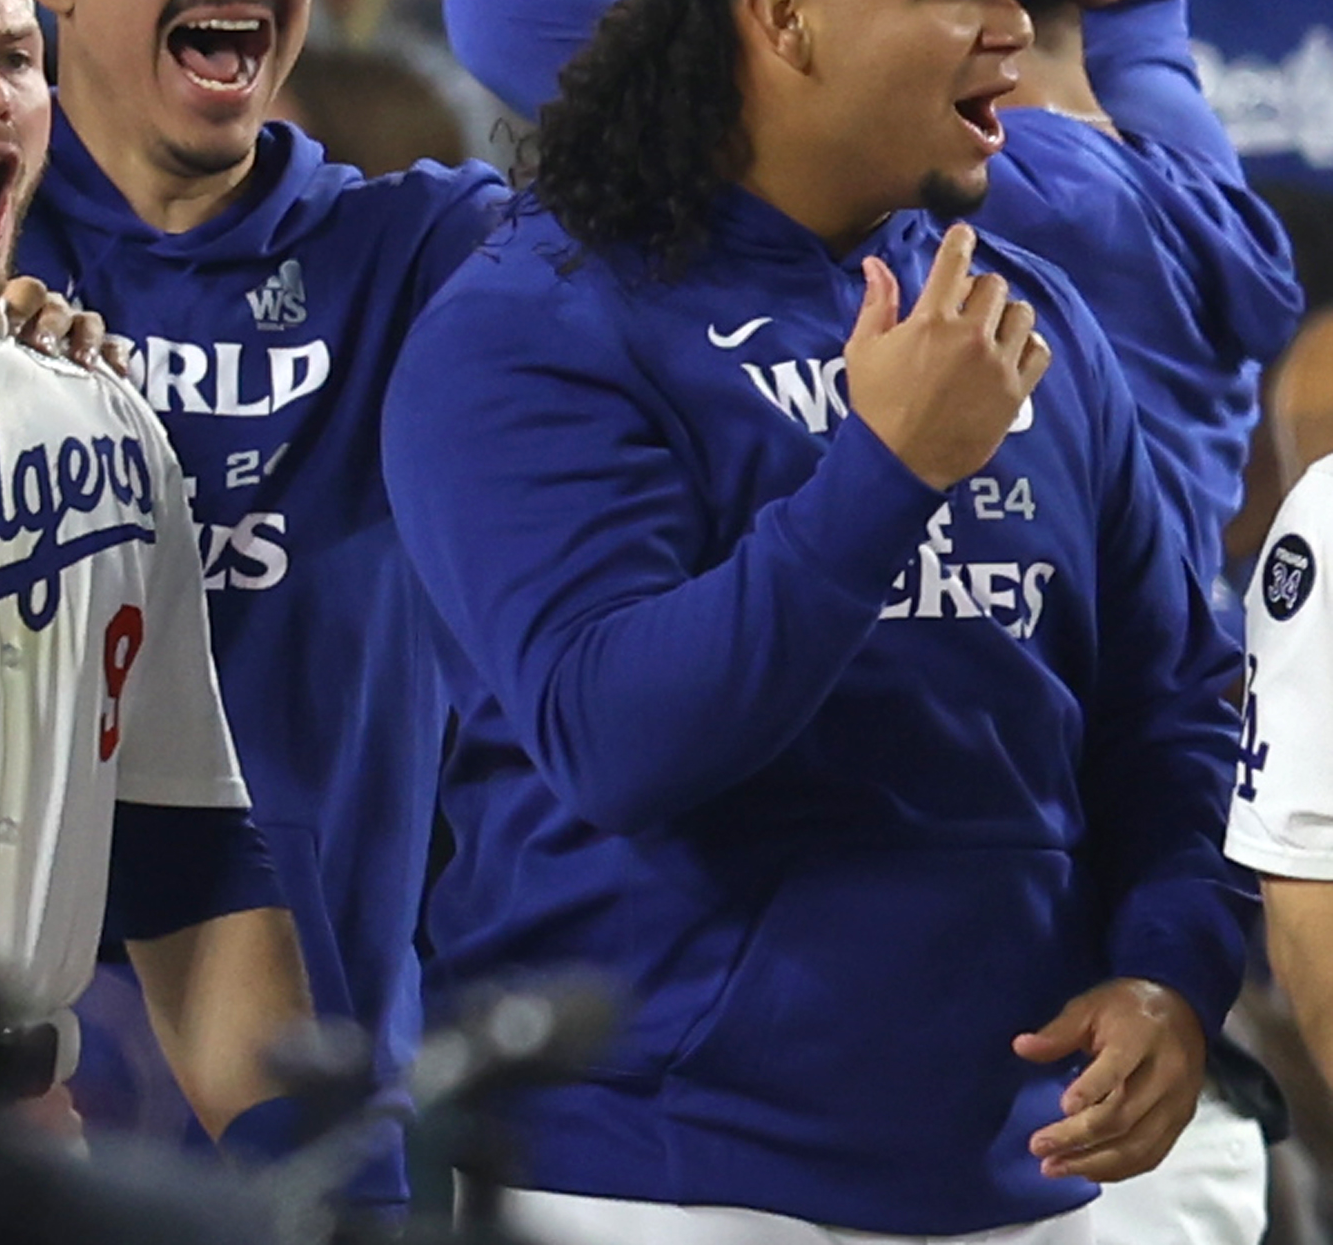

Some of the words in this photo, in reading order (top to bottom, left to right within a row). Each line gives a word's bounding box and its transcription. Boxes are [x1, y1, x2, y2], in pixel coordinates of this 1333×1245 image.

[245, 288, 308, 324] WS
[130, 335, 331, 417] RLD
[970, 477, 1036, 521] 24
[1267, 561, 1303, 610] 34
[99, 603, 144, 763] 9
